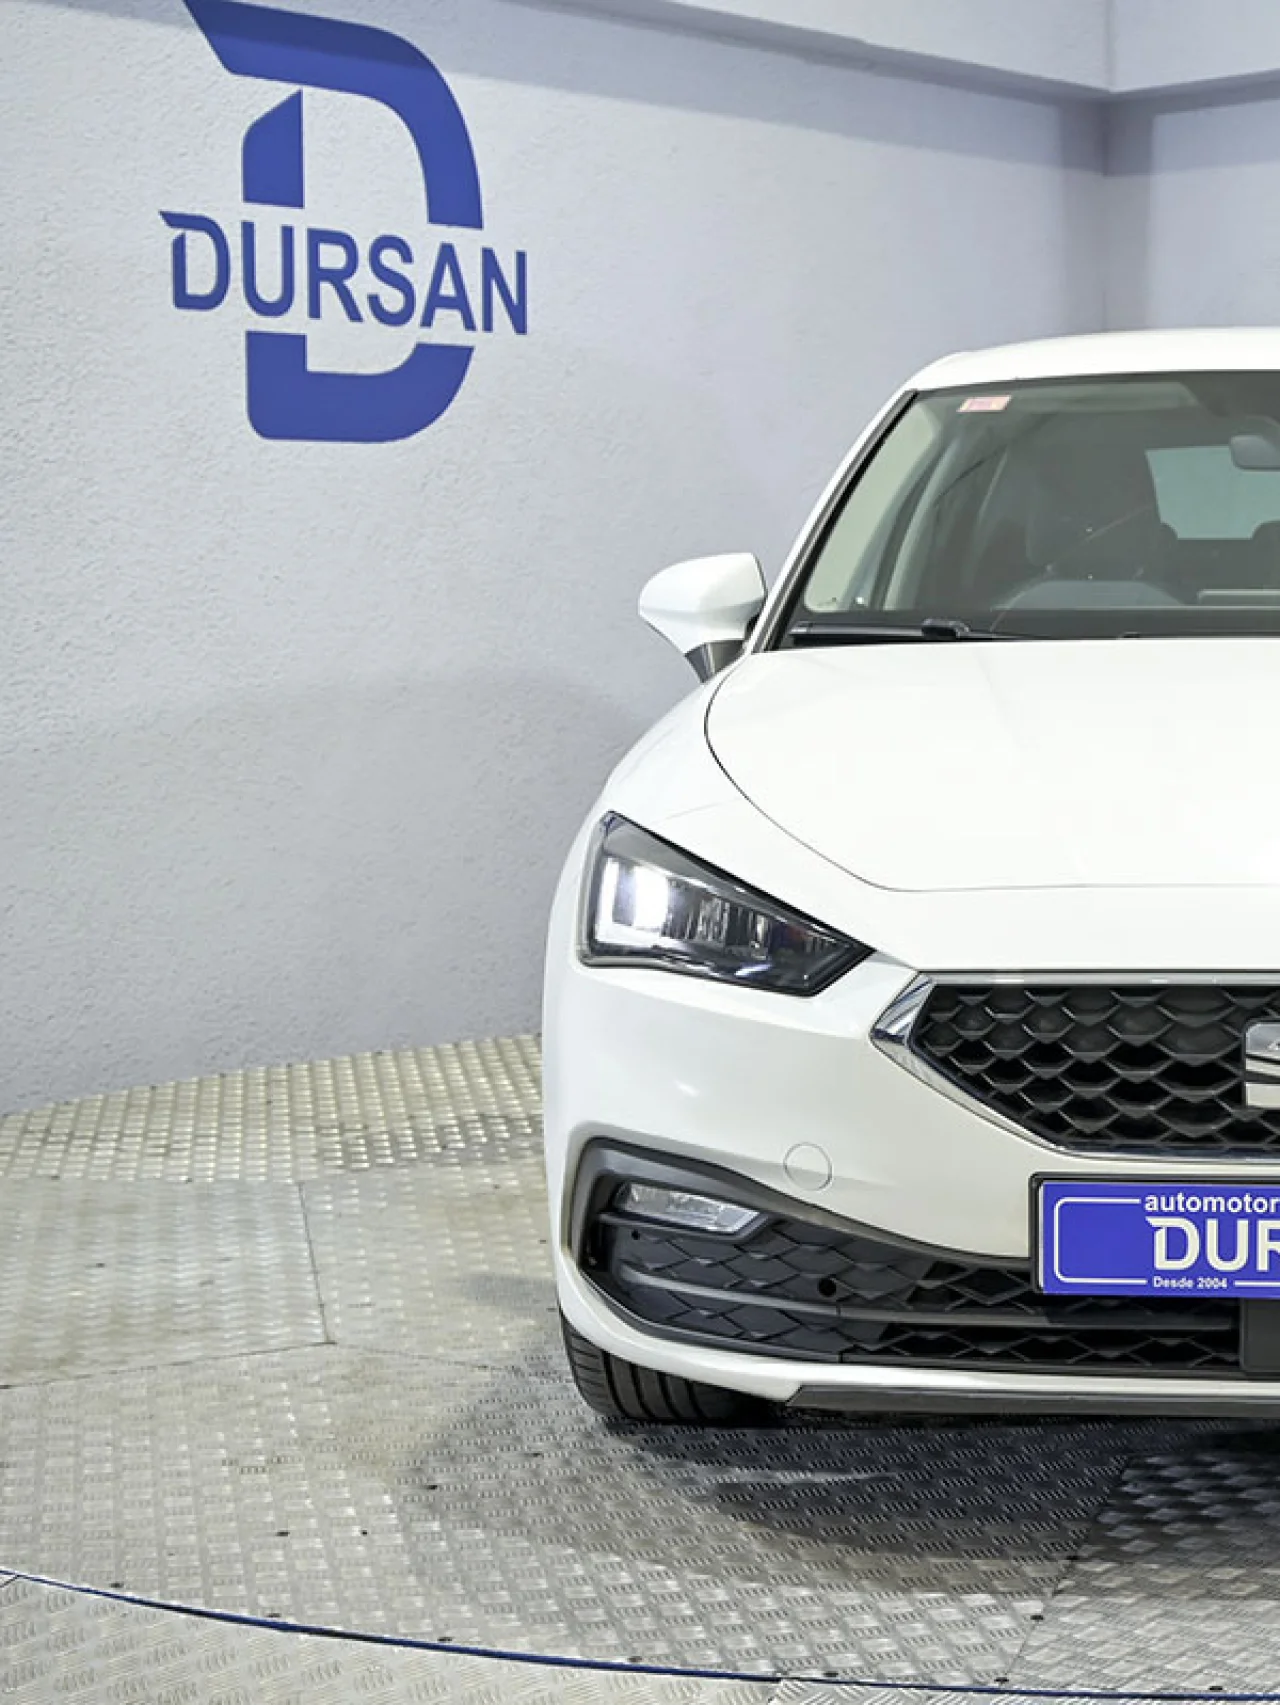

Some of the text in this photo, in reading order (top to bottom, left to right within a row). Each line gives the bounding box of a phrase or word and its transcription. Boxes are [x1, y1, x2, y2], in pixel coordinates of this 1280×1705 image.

[158, 210, 529, 336] DURSAN
[1144, 1192, 1280, 1214] automotor
[1153, 1275, 1229, 1290] Desde 2004
